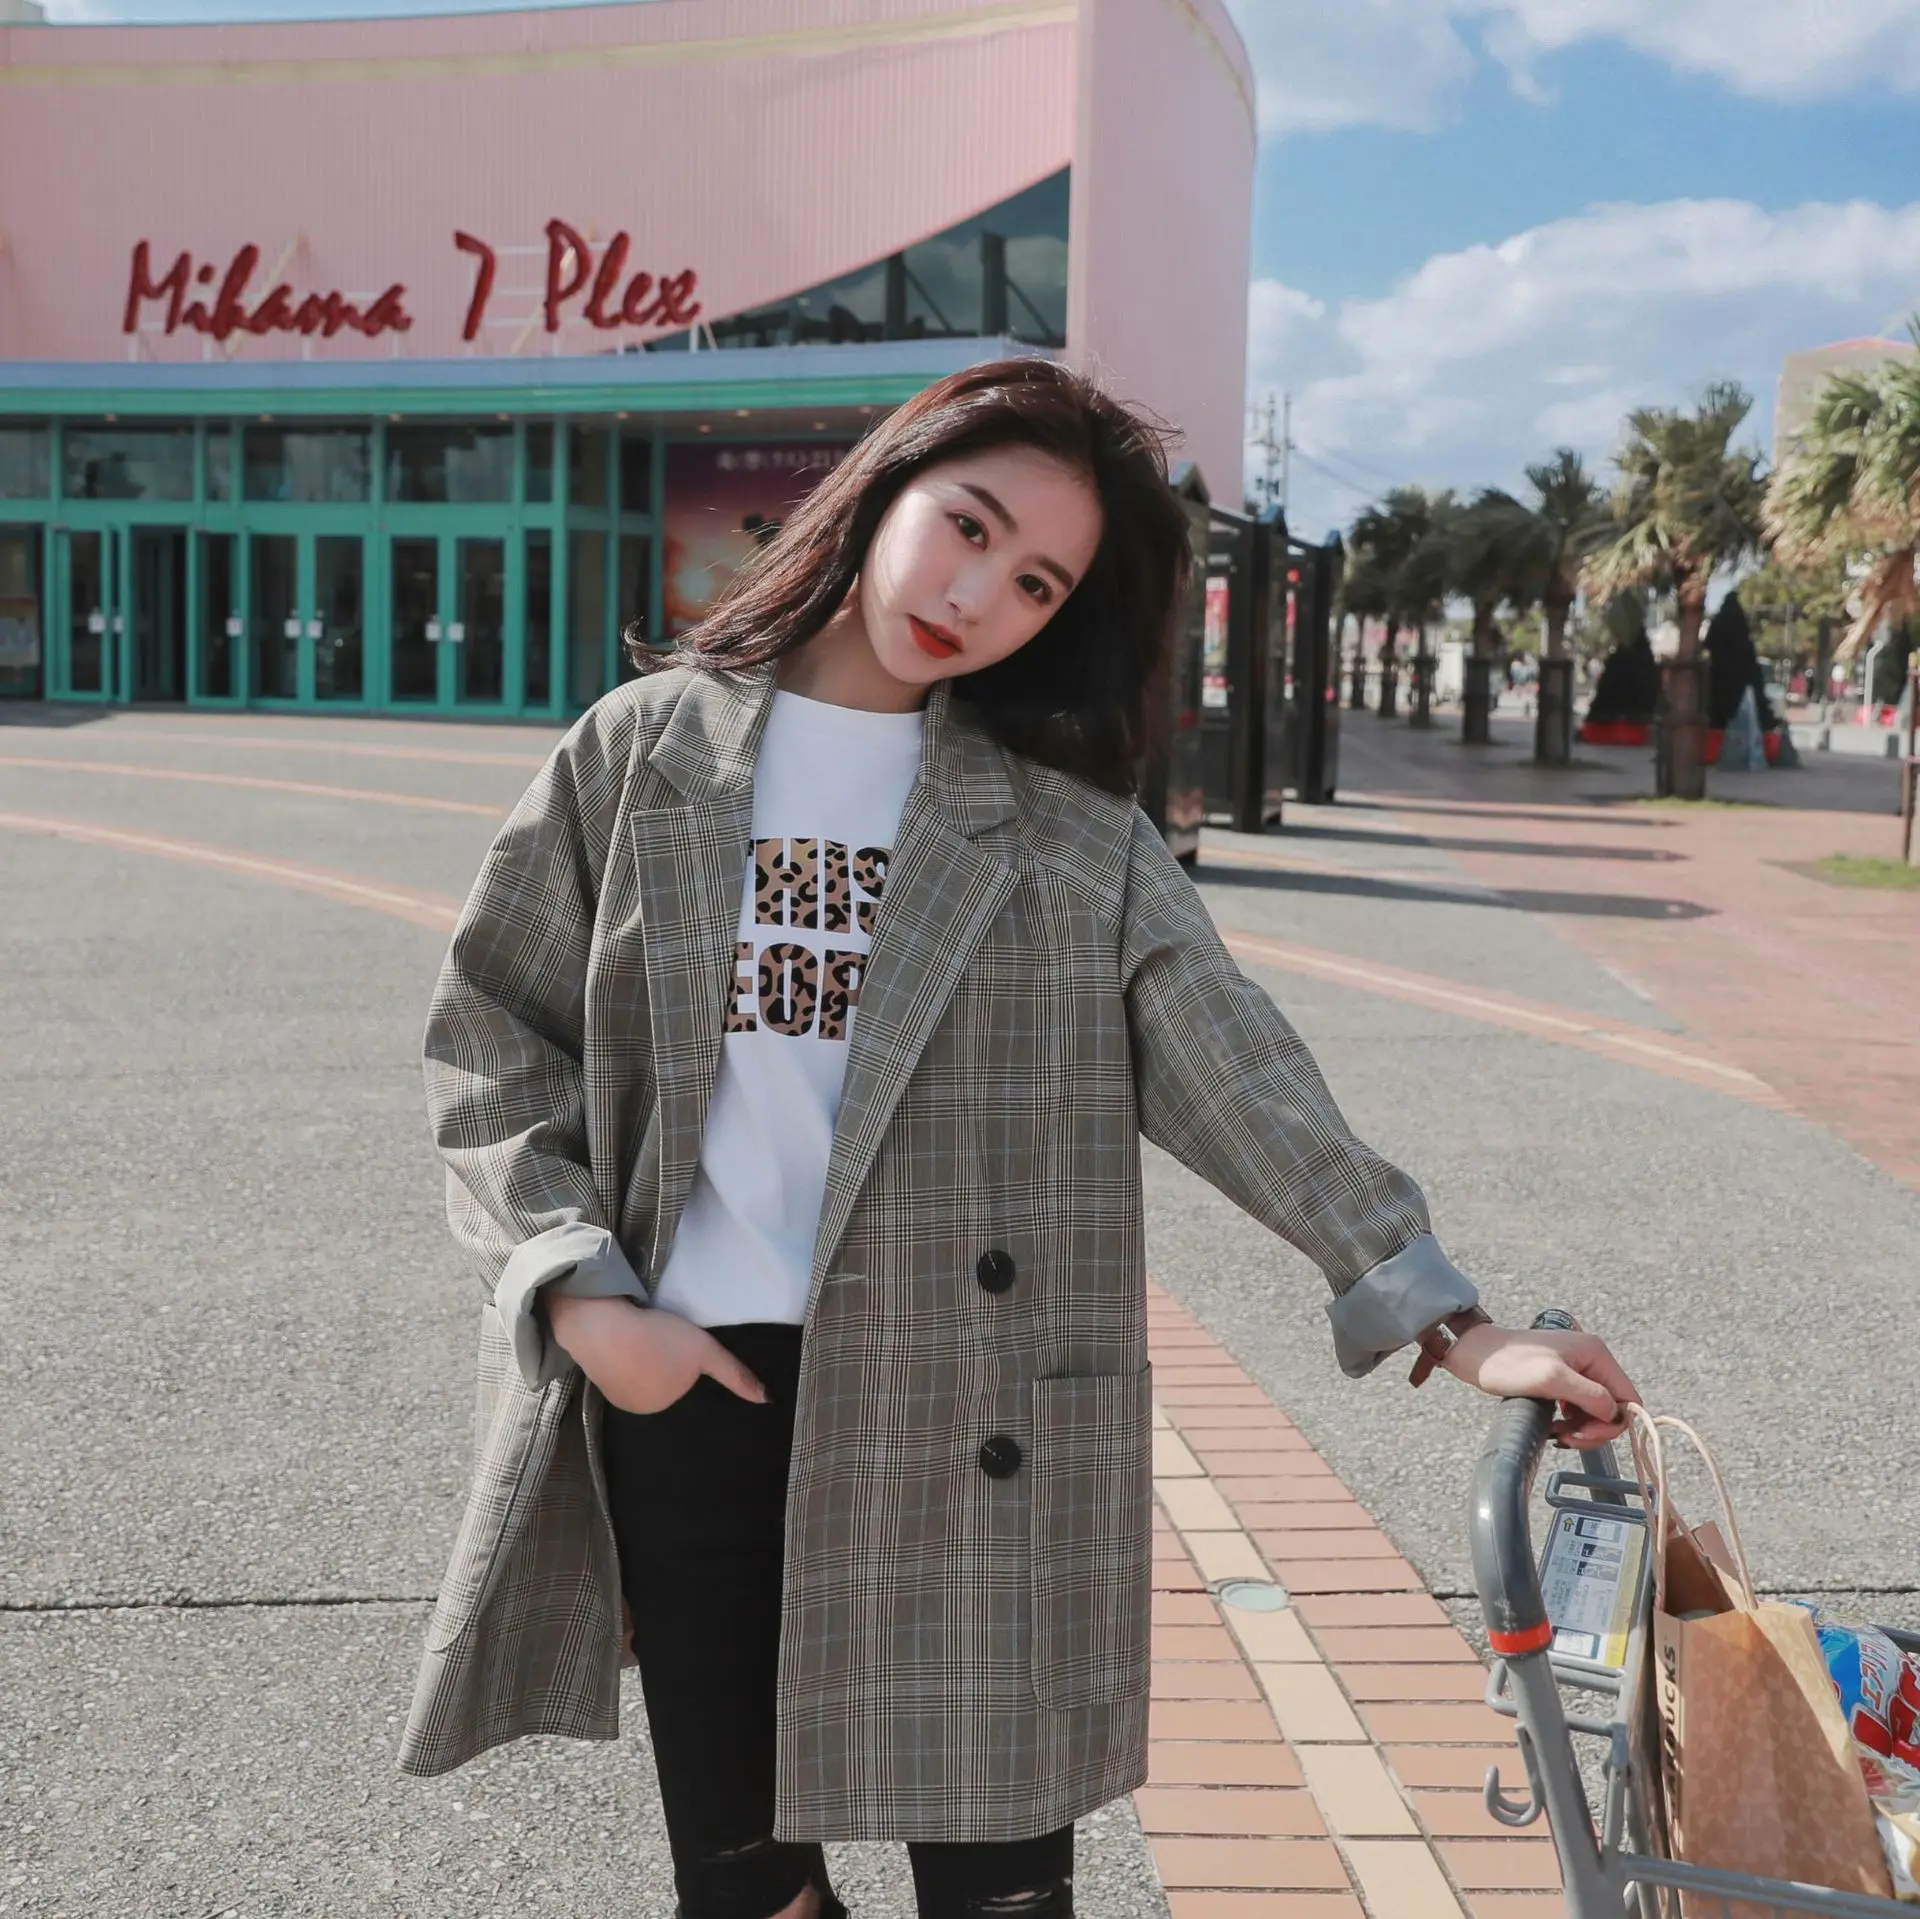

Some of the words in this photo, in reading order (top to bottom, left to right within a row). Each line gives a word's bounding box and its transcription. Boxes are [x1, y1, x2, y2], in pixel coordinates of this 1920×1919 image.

[123, 239, 413, 341] Mihama
[452, 230, 496, 342] 7
[545, 218, 702, 334] Plex
[748, 837, 893, 936] HIS
